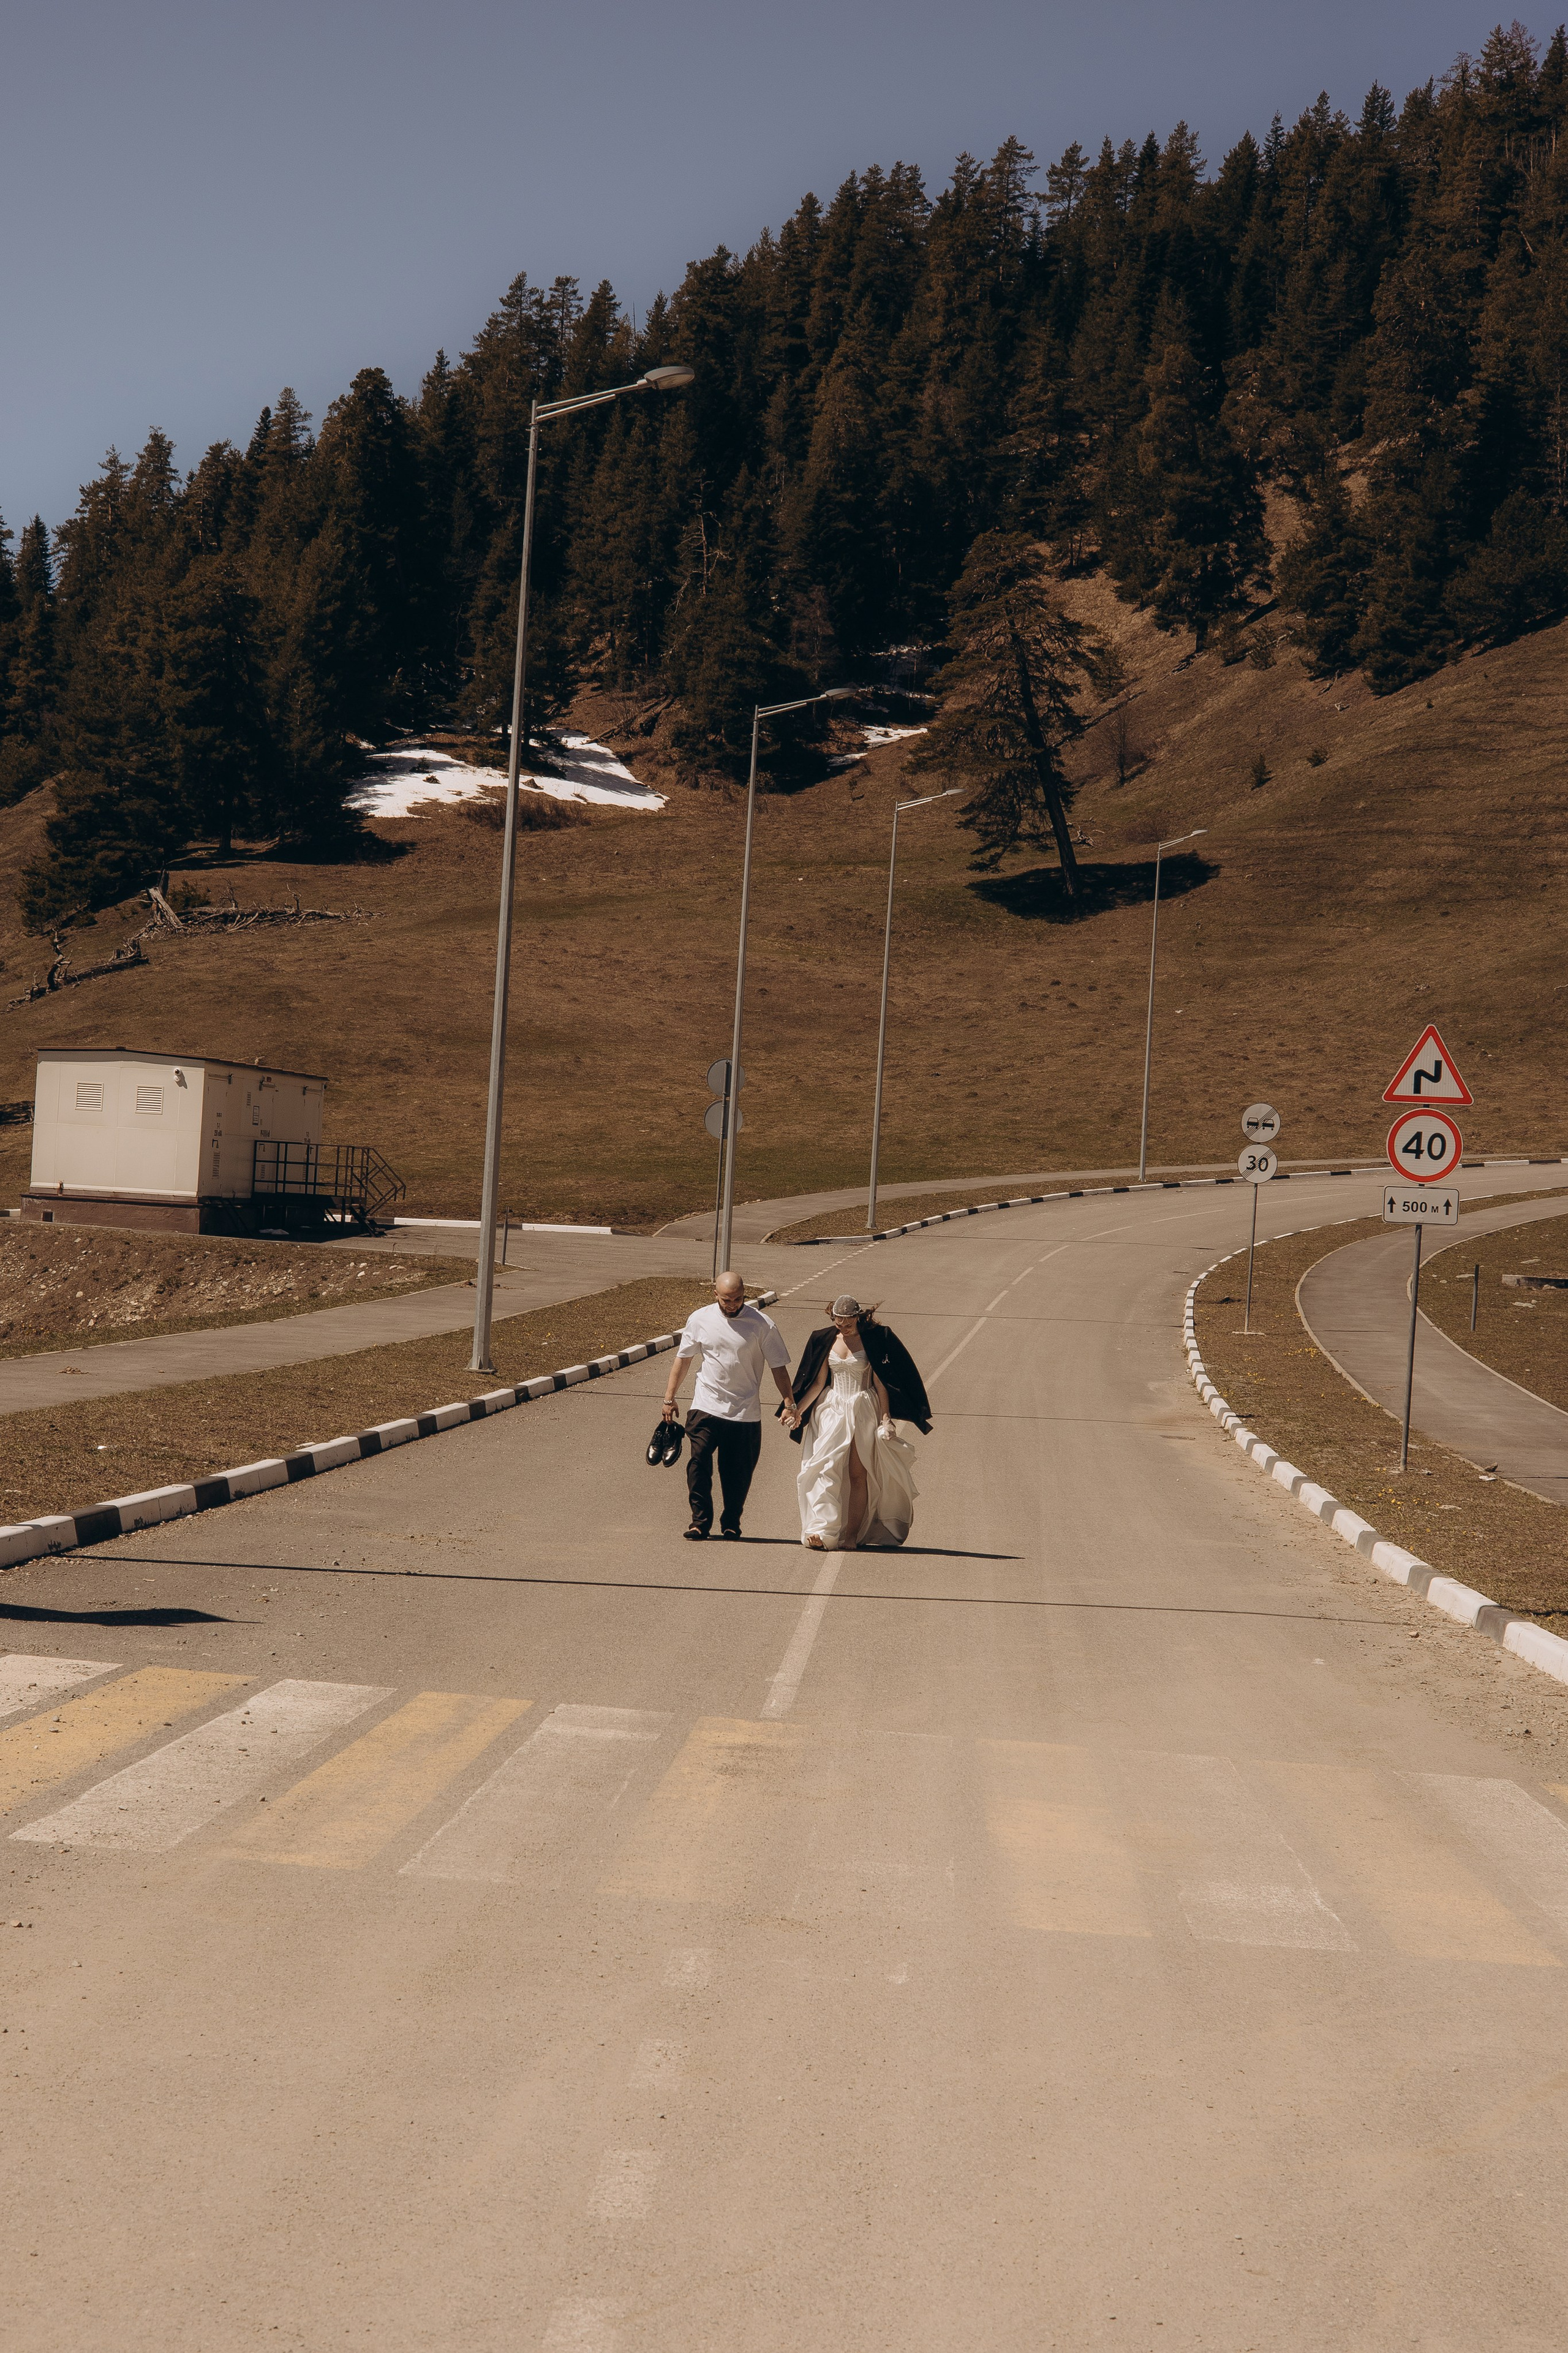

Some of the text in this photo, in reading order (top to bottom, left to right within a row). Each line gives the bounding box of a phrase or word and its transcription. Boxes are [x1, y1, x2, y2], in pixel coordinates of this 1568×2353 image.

[1402, 1131, 1446, 1160] 40
[1246, 1155, 1268, 1172] 30
[1402, 1201, 1427, 1213] 500
